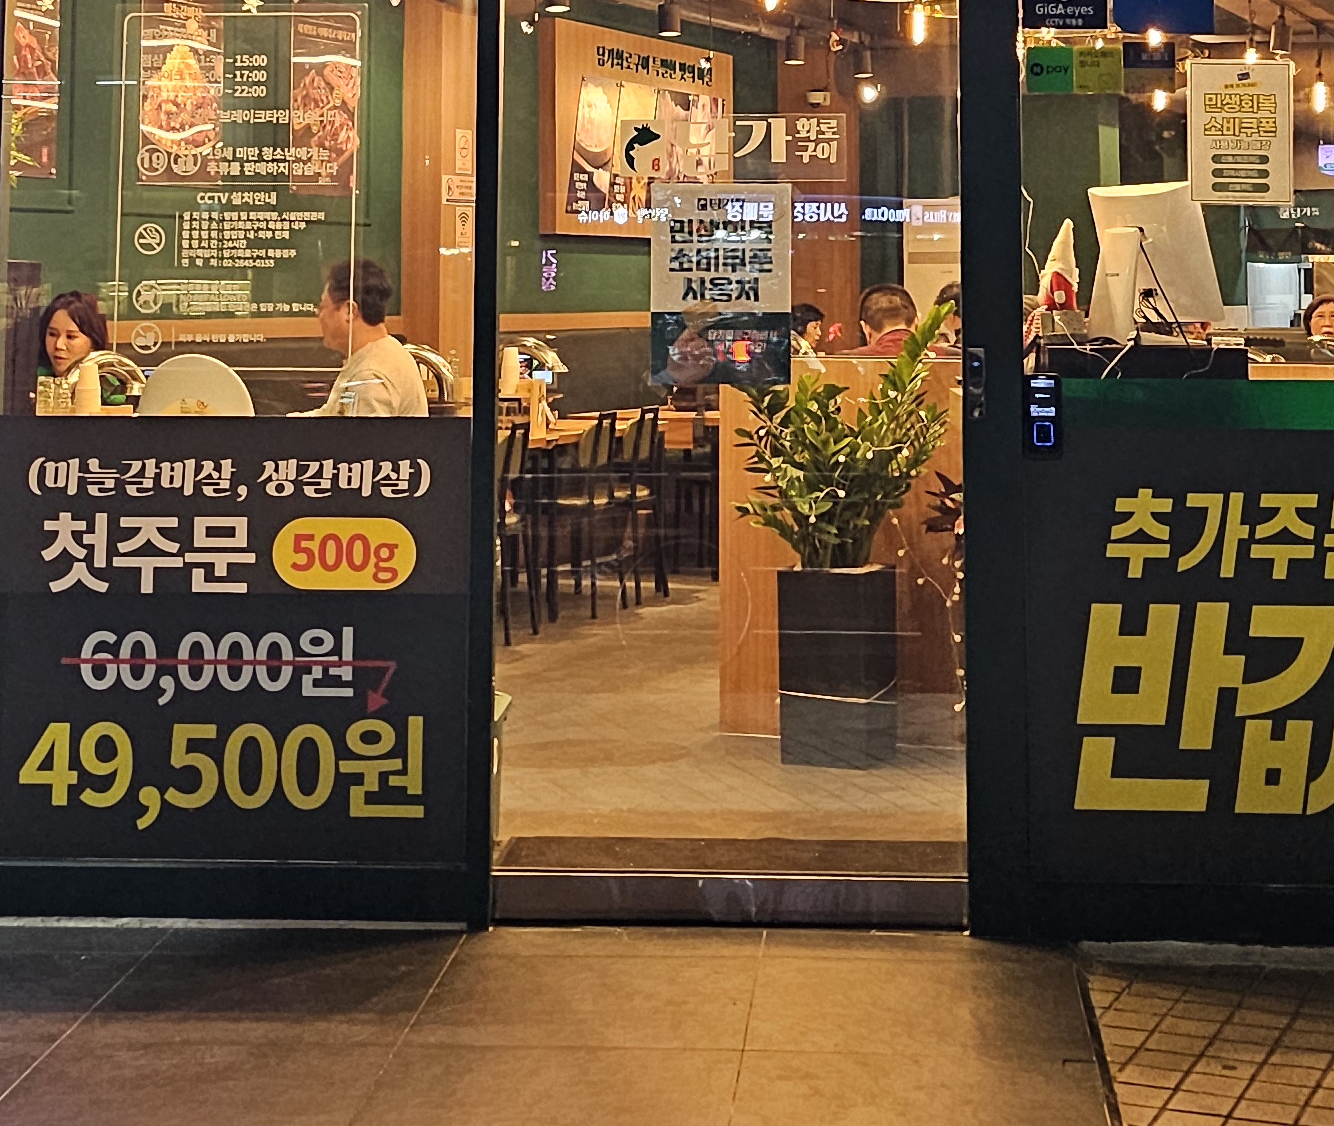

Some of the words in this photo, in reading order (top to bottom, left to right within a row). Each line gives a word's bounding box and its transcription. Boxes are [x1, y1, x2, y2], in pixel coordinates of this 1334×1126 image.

[234, 54, 268, 67] 15:00
[1046, 64, 1070, 76] pay
[234, 70, 267, 82] 17:00
[233, 85, 267, 97] 22:00
[1203, 92, 1278, 115] 민생회복
[794, 117, 841, 141] 화로
[1203, 116, 1278, 138] 소비쿠폰
[236, 146, 260, 161] 미만
[794, 141, 839, 164] 구이
[243, 161, 289, 176] 판매하지
[292, 161, 338, 176] 않습니다
[196, 191, 229, 204] CCTV
[230, 191, 277, 205] 설치안내
[681, 276, 761, 303] 사용처
[27, 456, 248, 501] (마늘갈비살,
[257, 457, 432, 499] 생갈비살)
[40, 511, 257, 594] 첫주문
[289, 532, 400, 585] 500g
[79, 626, 355, 707] 60,000원
[17, 714, 426, 831] 49,500원
